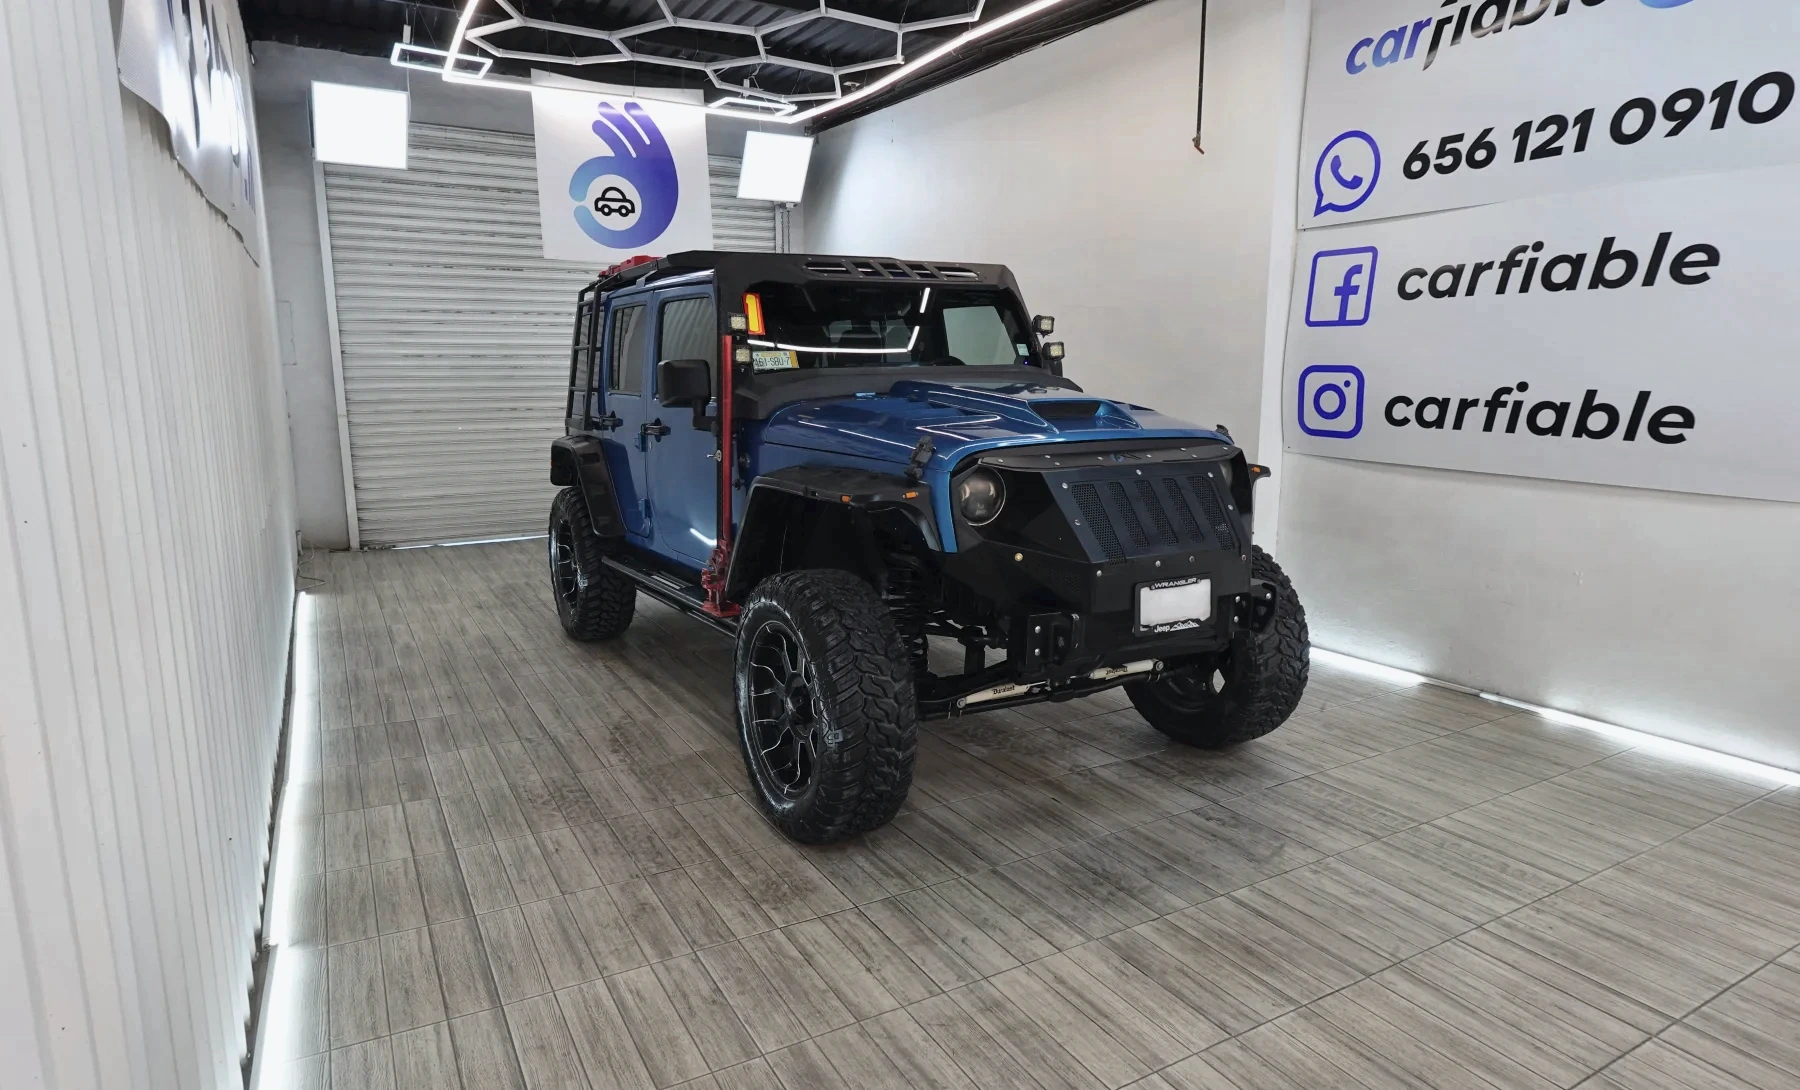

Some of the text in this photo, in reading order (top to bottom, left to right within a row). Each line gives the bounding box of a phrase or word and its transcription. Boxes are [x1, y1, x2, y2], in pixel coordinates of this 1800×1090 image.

[1345, 0, 1602, 75] carfiab
[1402, 71, 1795, 180] 656 121 0910
[1397, 231, 1720, 301] carfiable
[1384, 381, 1695, 445] carfiable
[1153, 577, 1198, 589] WRANGLER
[1154, 623, 1171, 634] Jeep
